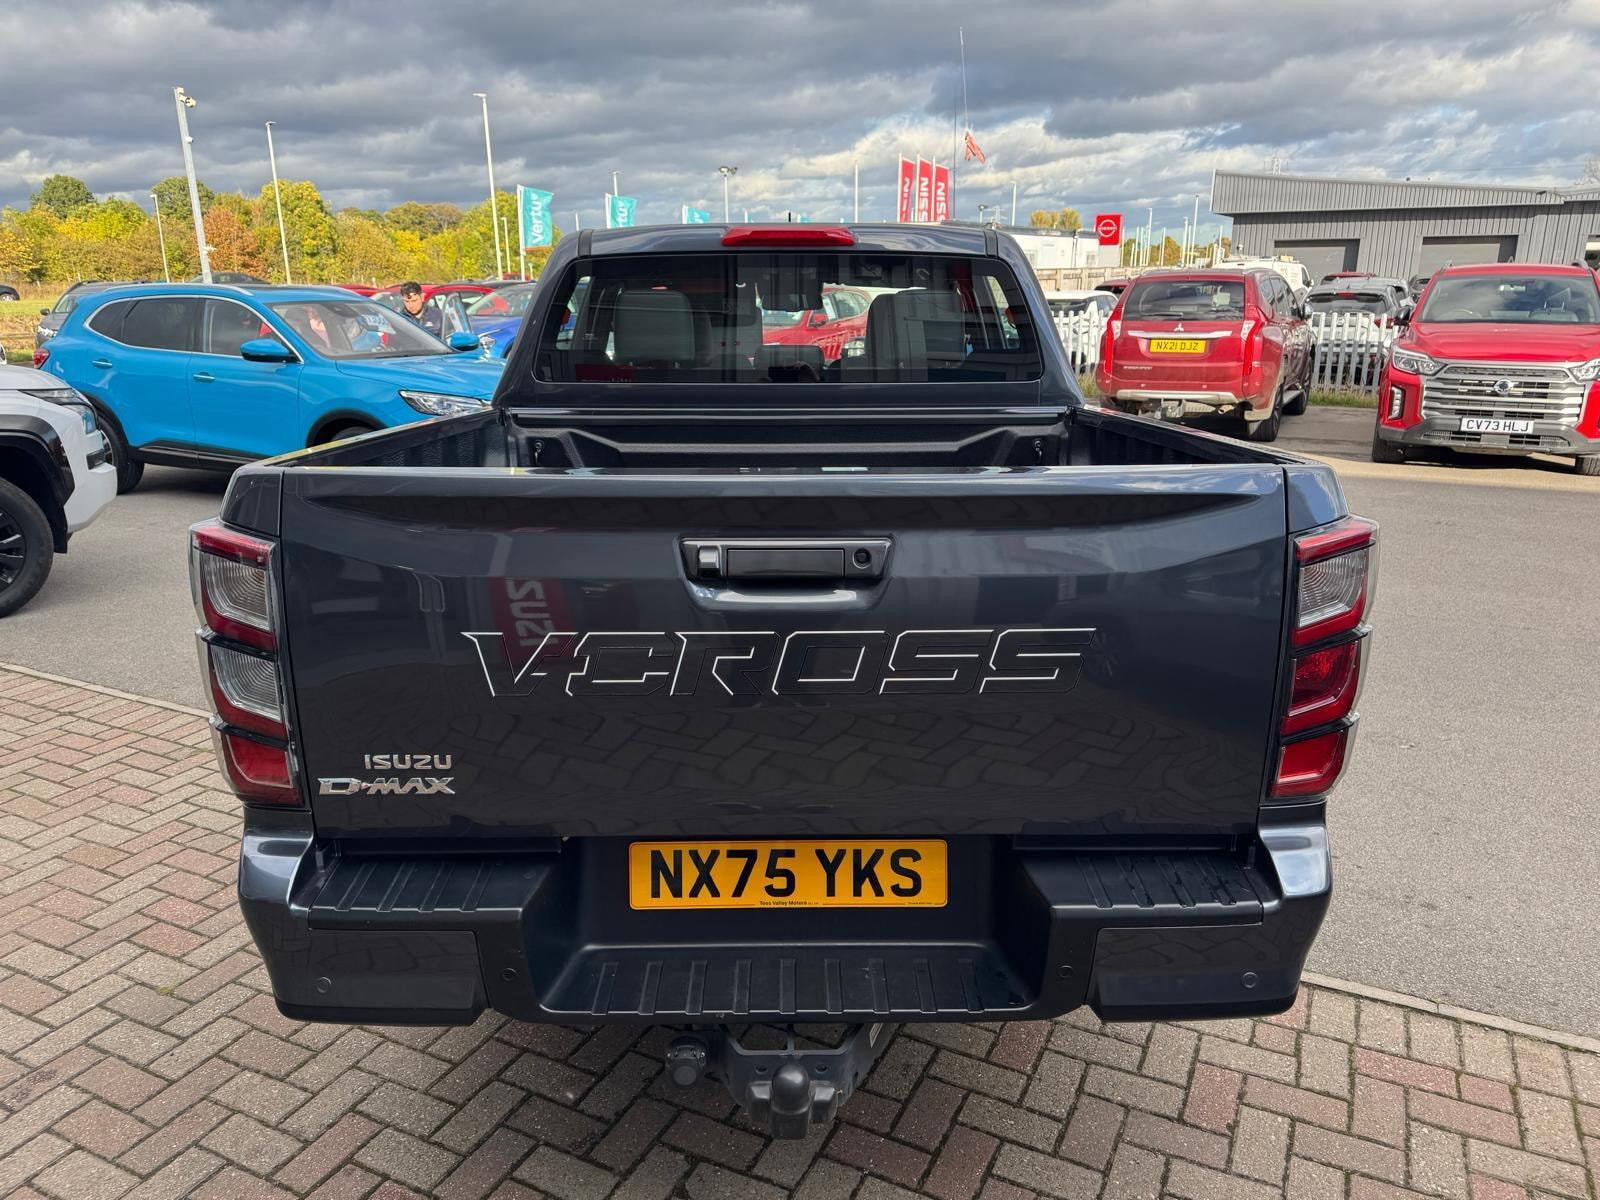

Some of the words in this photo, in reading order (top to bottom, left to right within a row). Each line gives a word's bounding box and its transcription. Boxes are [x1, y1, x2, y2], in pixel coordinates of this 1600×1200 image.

[1156, 341, 1177, 350] NX21
[1180, 342, 1199, 351] DJZ
[1466, 419, 1500, 431] CV73
[1503, 421, 1530, 432] HLJ
[364, 754, 452, 770] ISUZU
[317, 777, 456, 795] D-MAX
[650, 848, 796, 898] NX75
[814, 848, 922, 897] YKS
